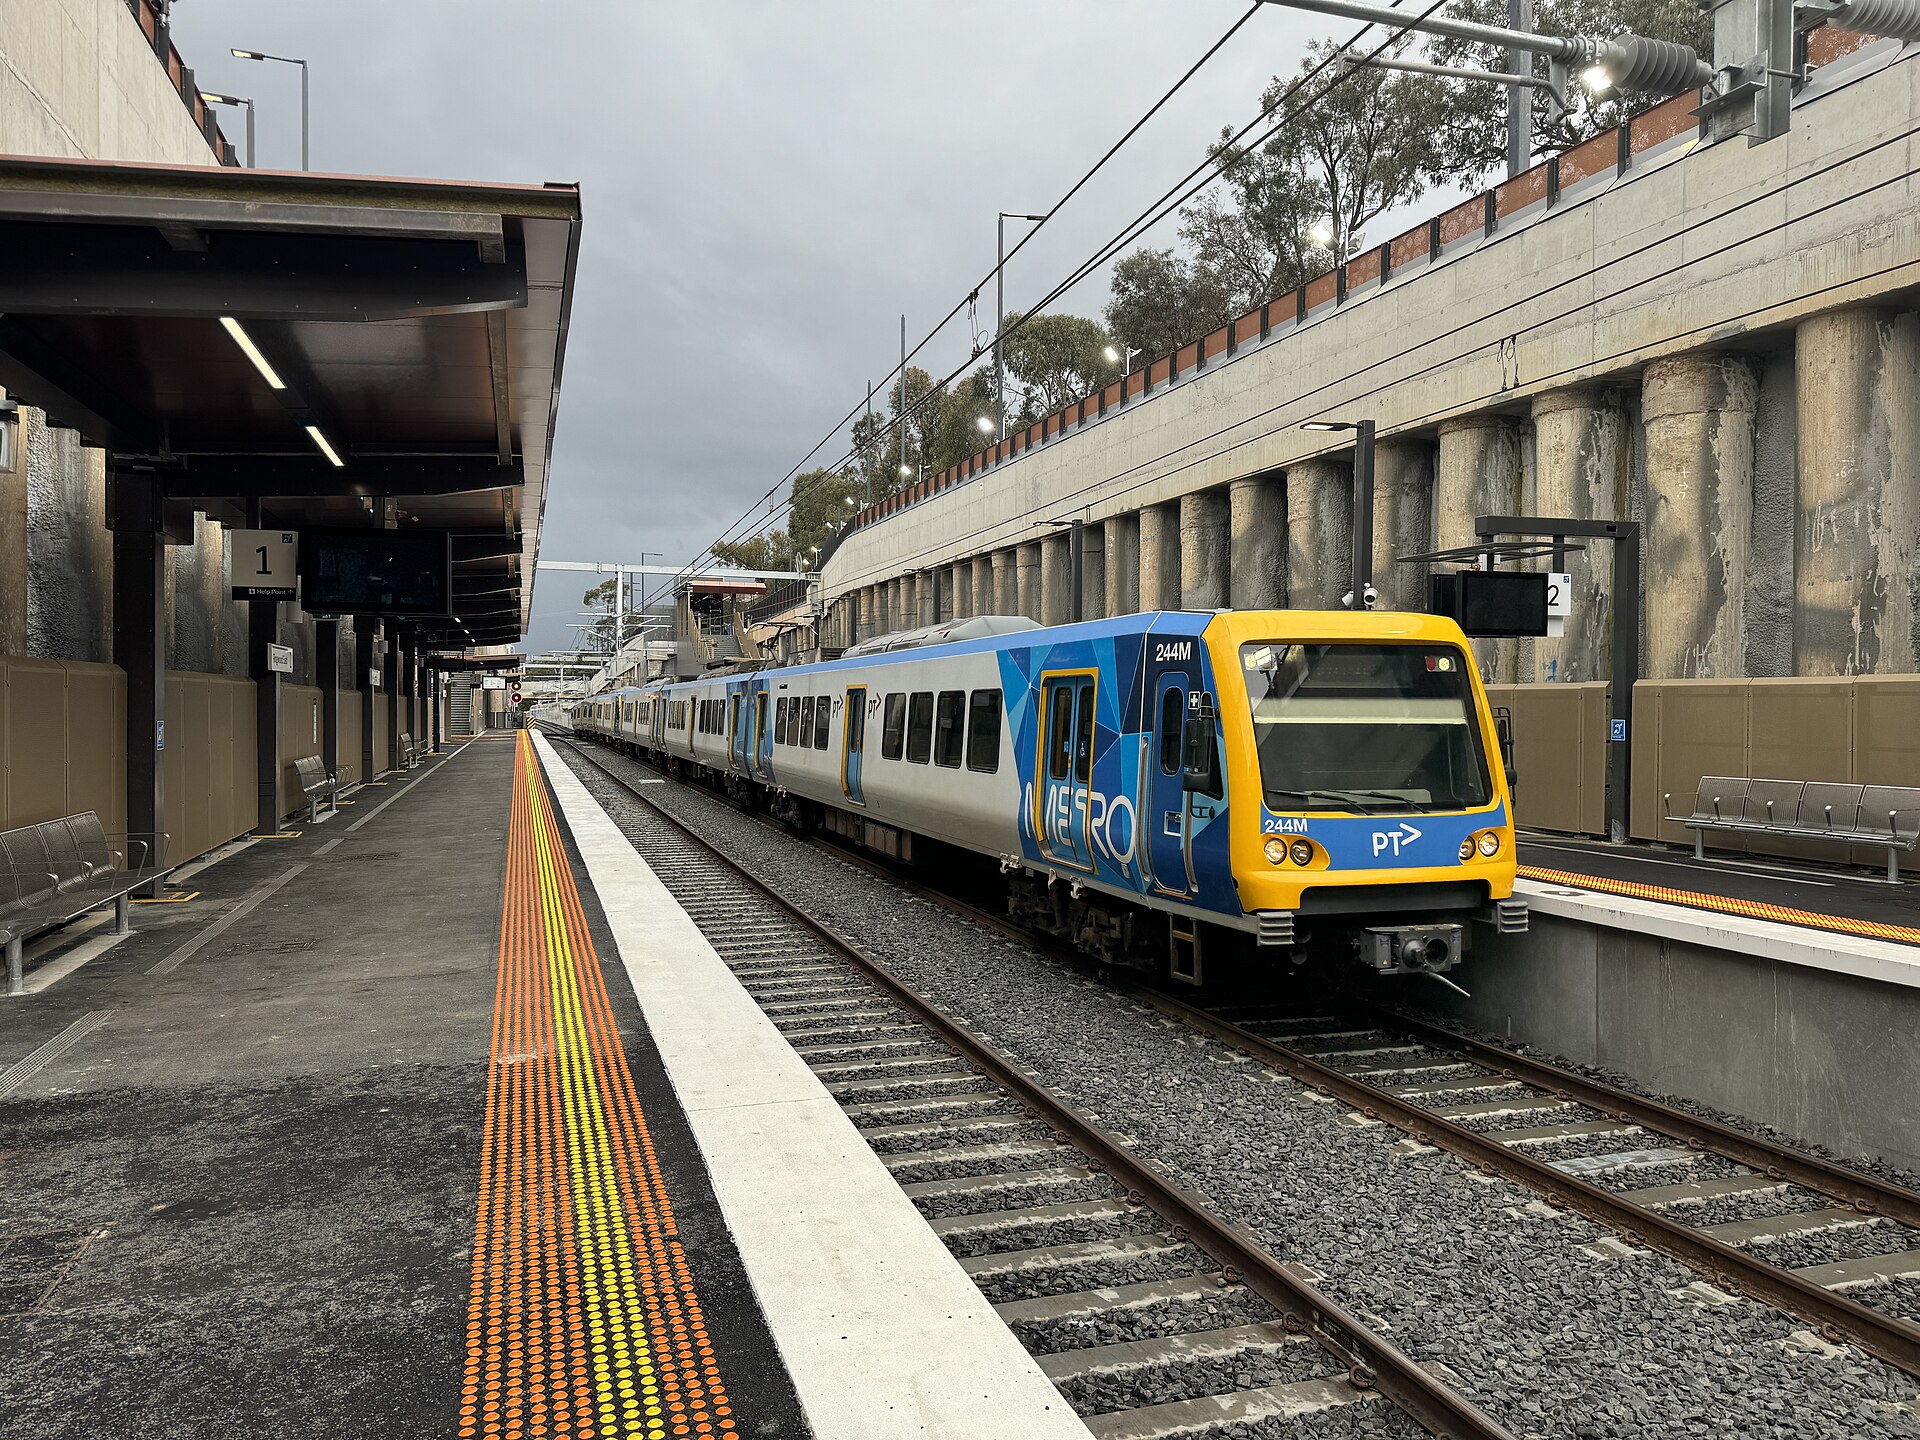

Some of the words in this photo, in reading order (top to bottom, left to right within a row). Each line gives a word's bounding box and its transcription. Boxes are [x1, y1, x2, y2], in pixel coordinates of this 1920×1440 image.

[256, 546, 272, 575] 1
[1548, 584, 1559, 606] 2
[1155, 641, 1192, 662] 244M
[1024, 781, 1137, 864] METRO
[1264, 818, 1309, 833] 244M
